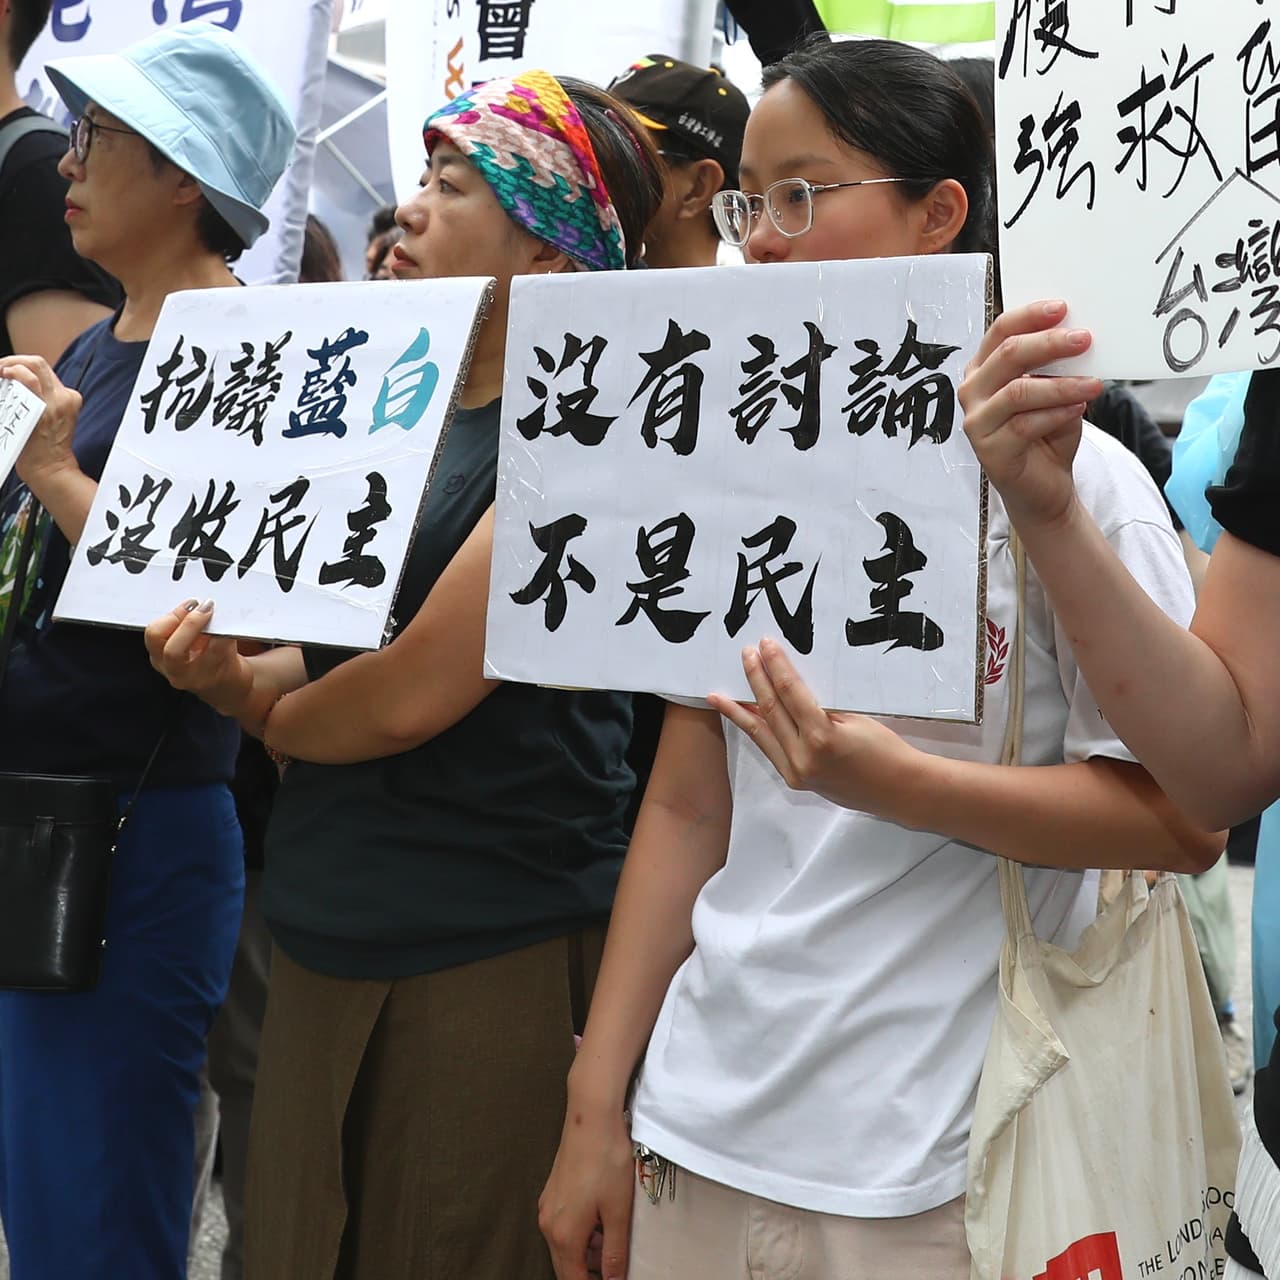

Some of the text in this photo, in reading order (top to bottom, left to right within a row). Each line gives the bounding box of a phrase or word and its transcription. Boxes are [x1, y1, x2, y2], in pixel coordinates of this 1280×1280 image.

[140, 327, 440, 447] 抗議藍白
[508, 511, 945, 656] 不是民主
[1137, 1253, 1164, 1279] THE
[1167, 1217, 1203, 1264] LOND
